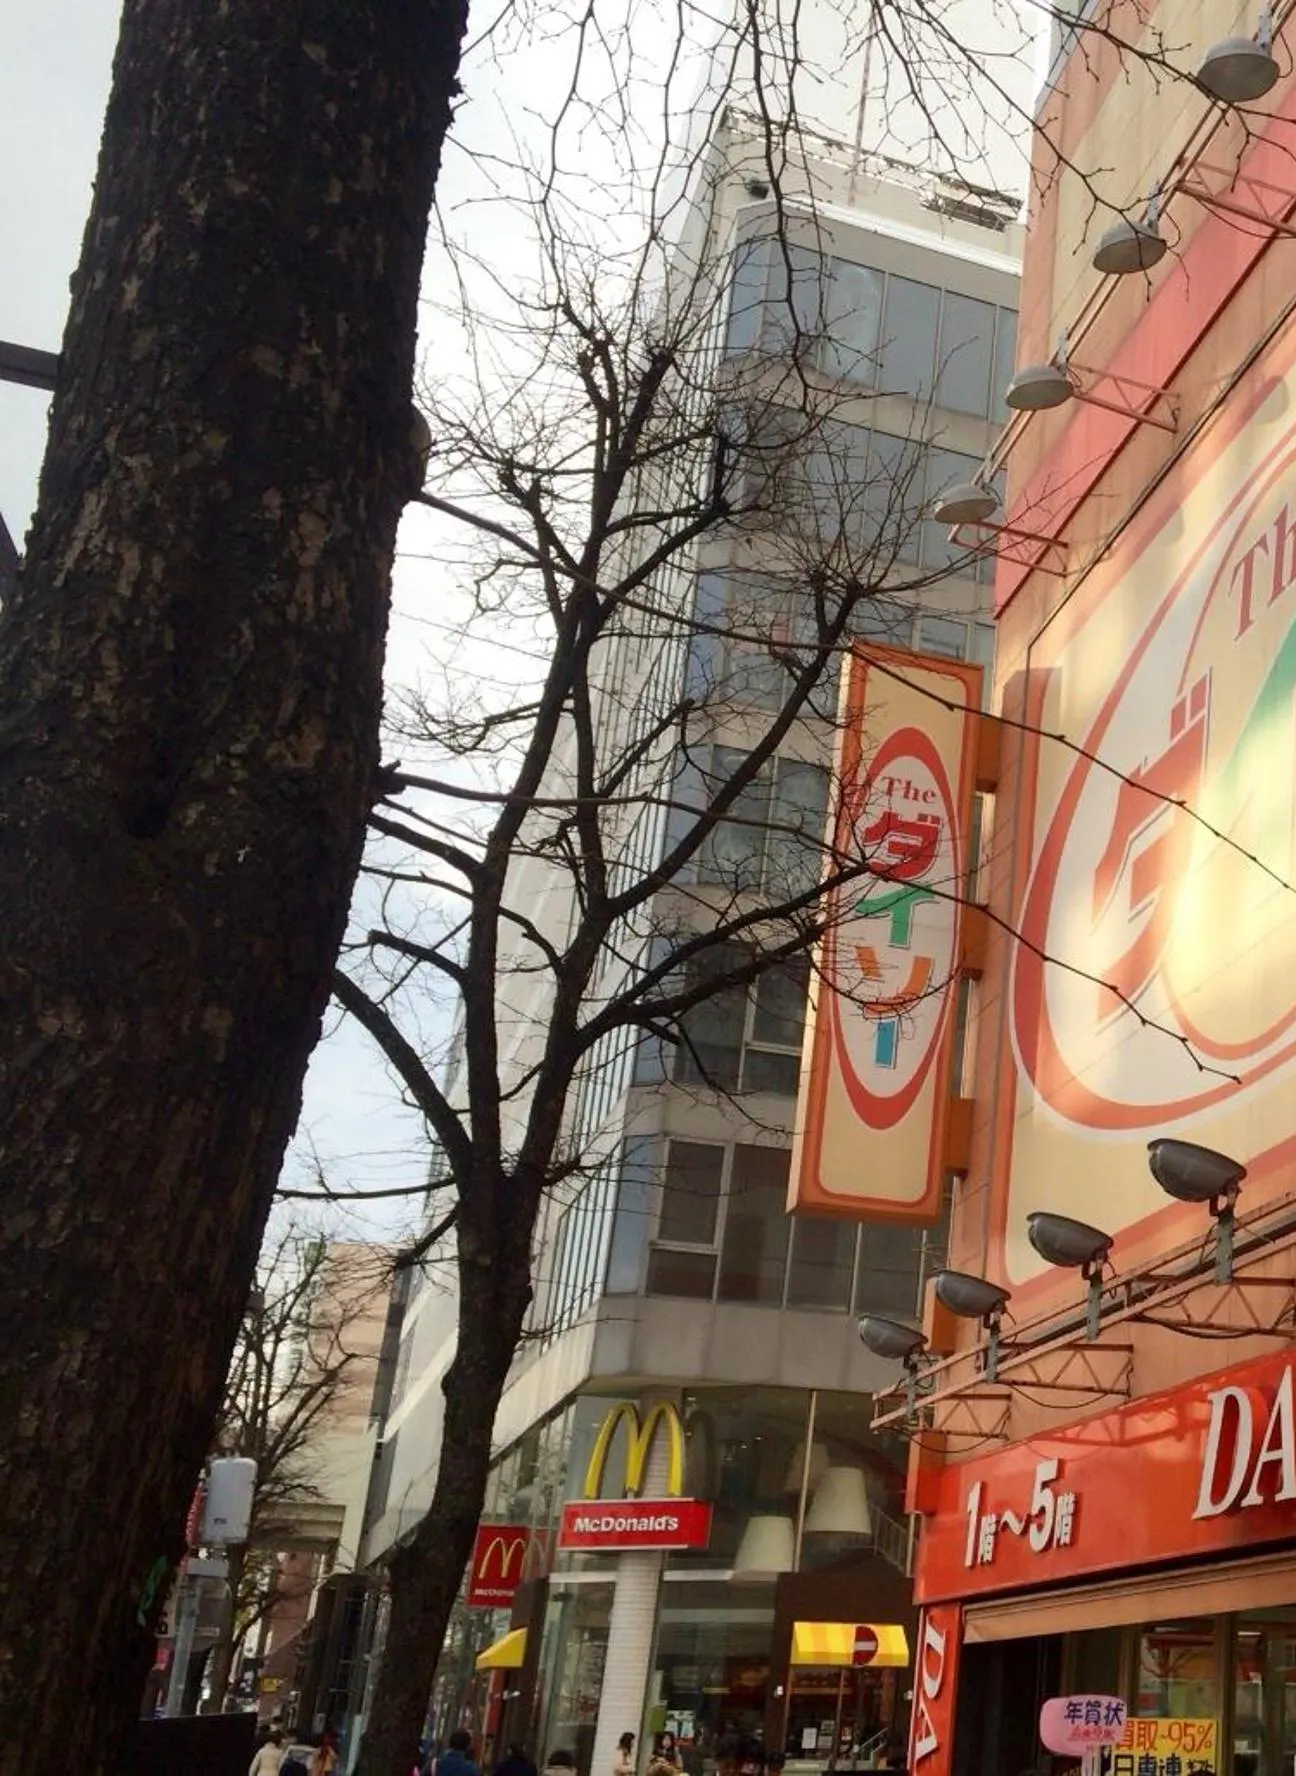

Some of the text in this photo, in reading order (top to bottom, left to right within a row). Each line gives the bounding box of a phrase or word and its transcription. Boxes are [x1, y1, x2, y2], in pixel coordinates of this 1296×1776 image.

[881, 775, 937, 805] The
[573, 1515, 679, 1533] McDonald's
[1064, 1699, 1125, 1727] 年賀状
